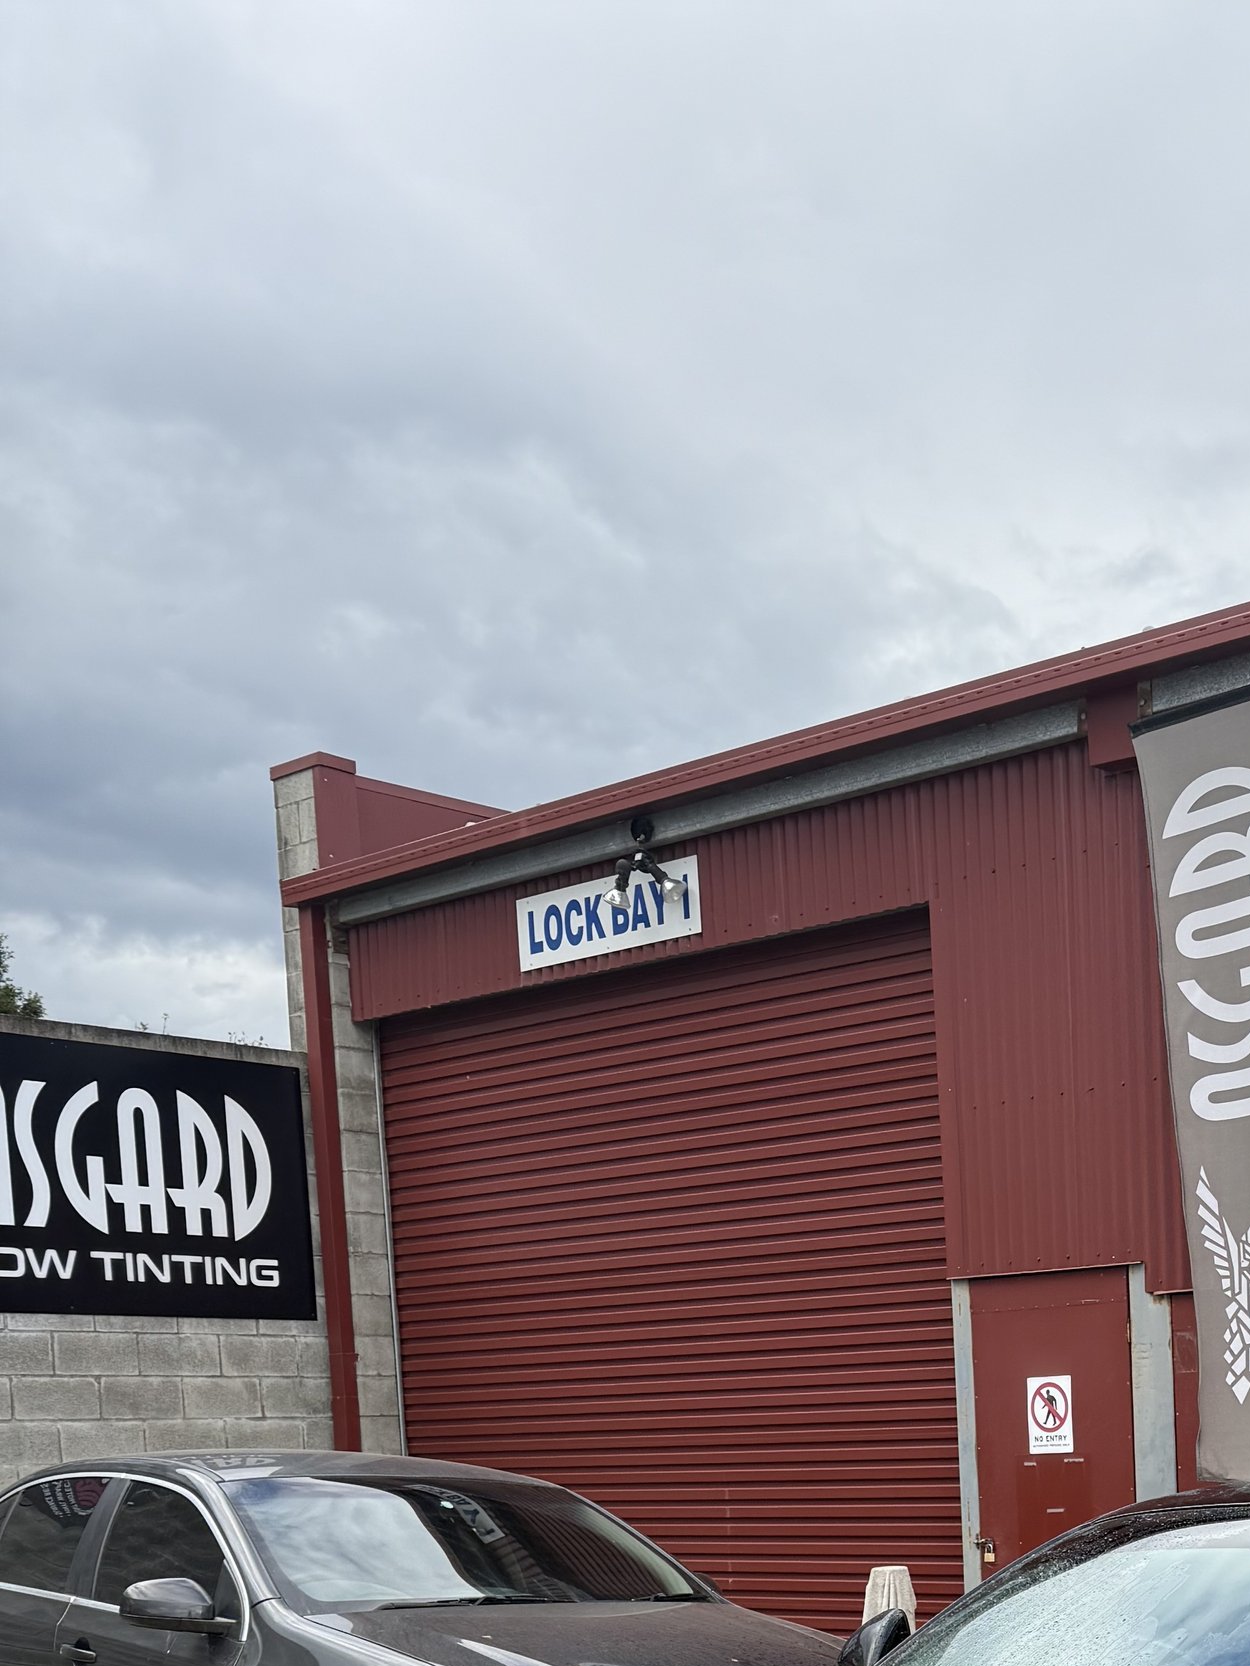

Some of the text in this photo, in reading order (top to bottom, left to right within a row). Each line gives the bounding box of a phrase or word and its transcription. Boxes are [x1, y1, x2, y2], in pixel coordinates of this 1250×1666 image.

[527, 893, 607, 955] LOCK
[611, 880, 665, 936] BAY
[90, 1251, 280, 1288] TINTING
[1046, 1434, 1068, 1443] ENTRY
